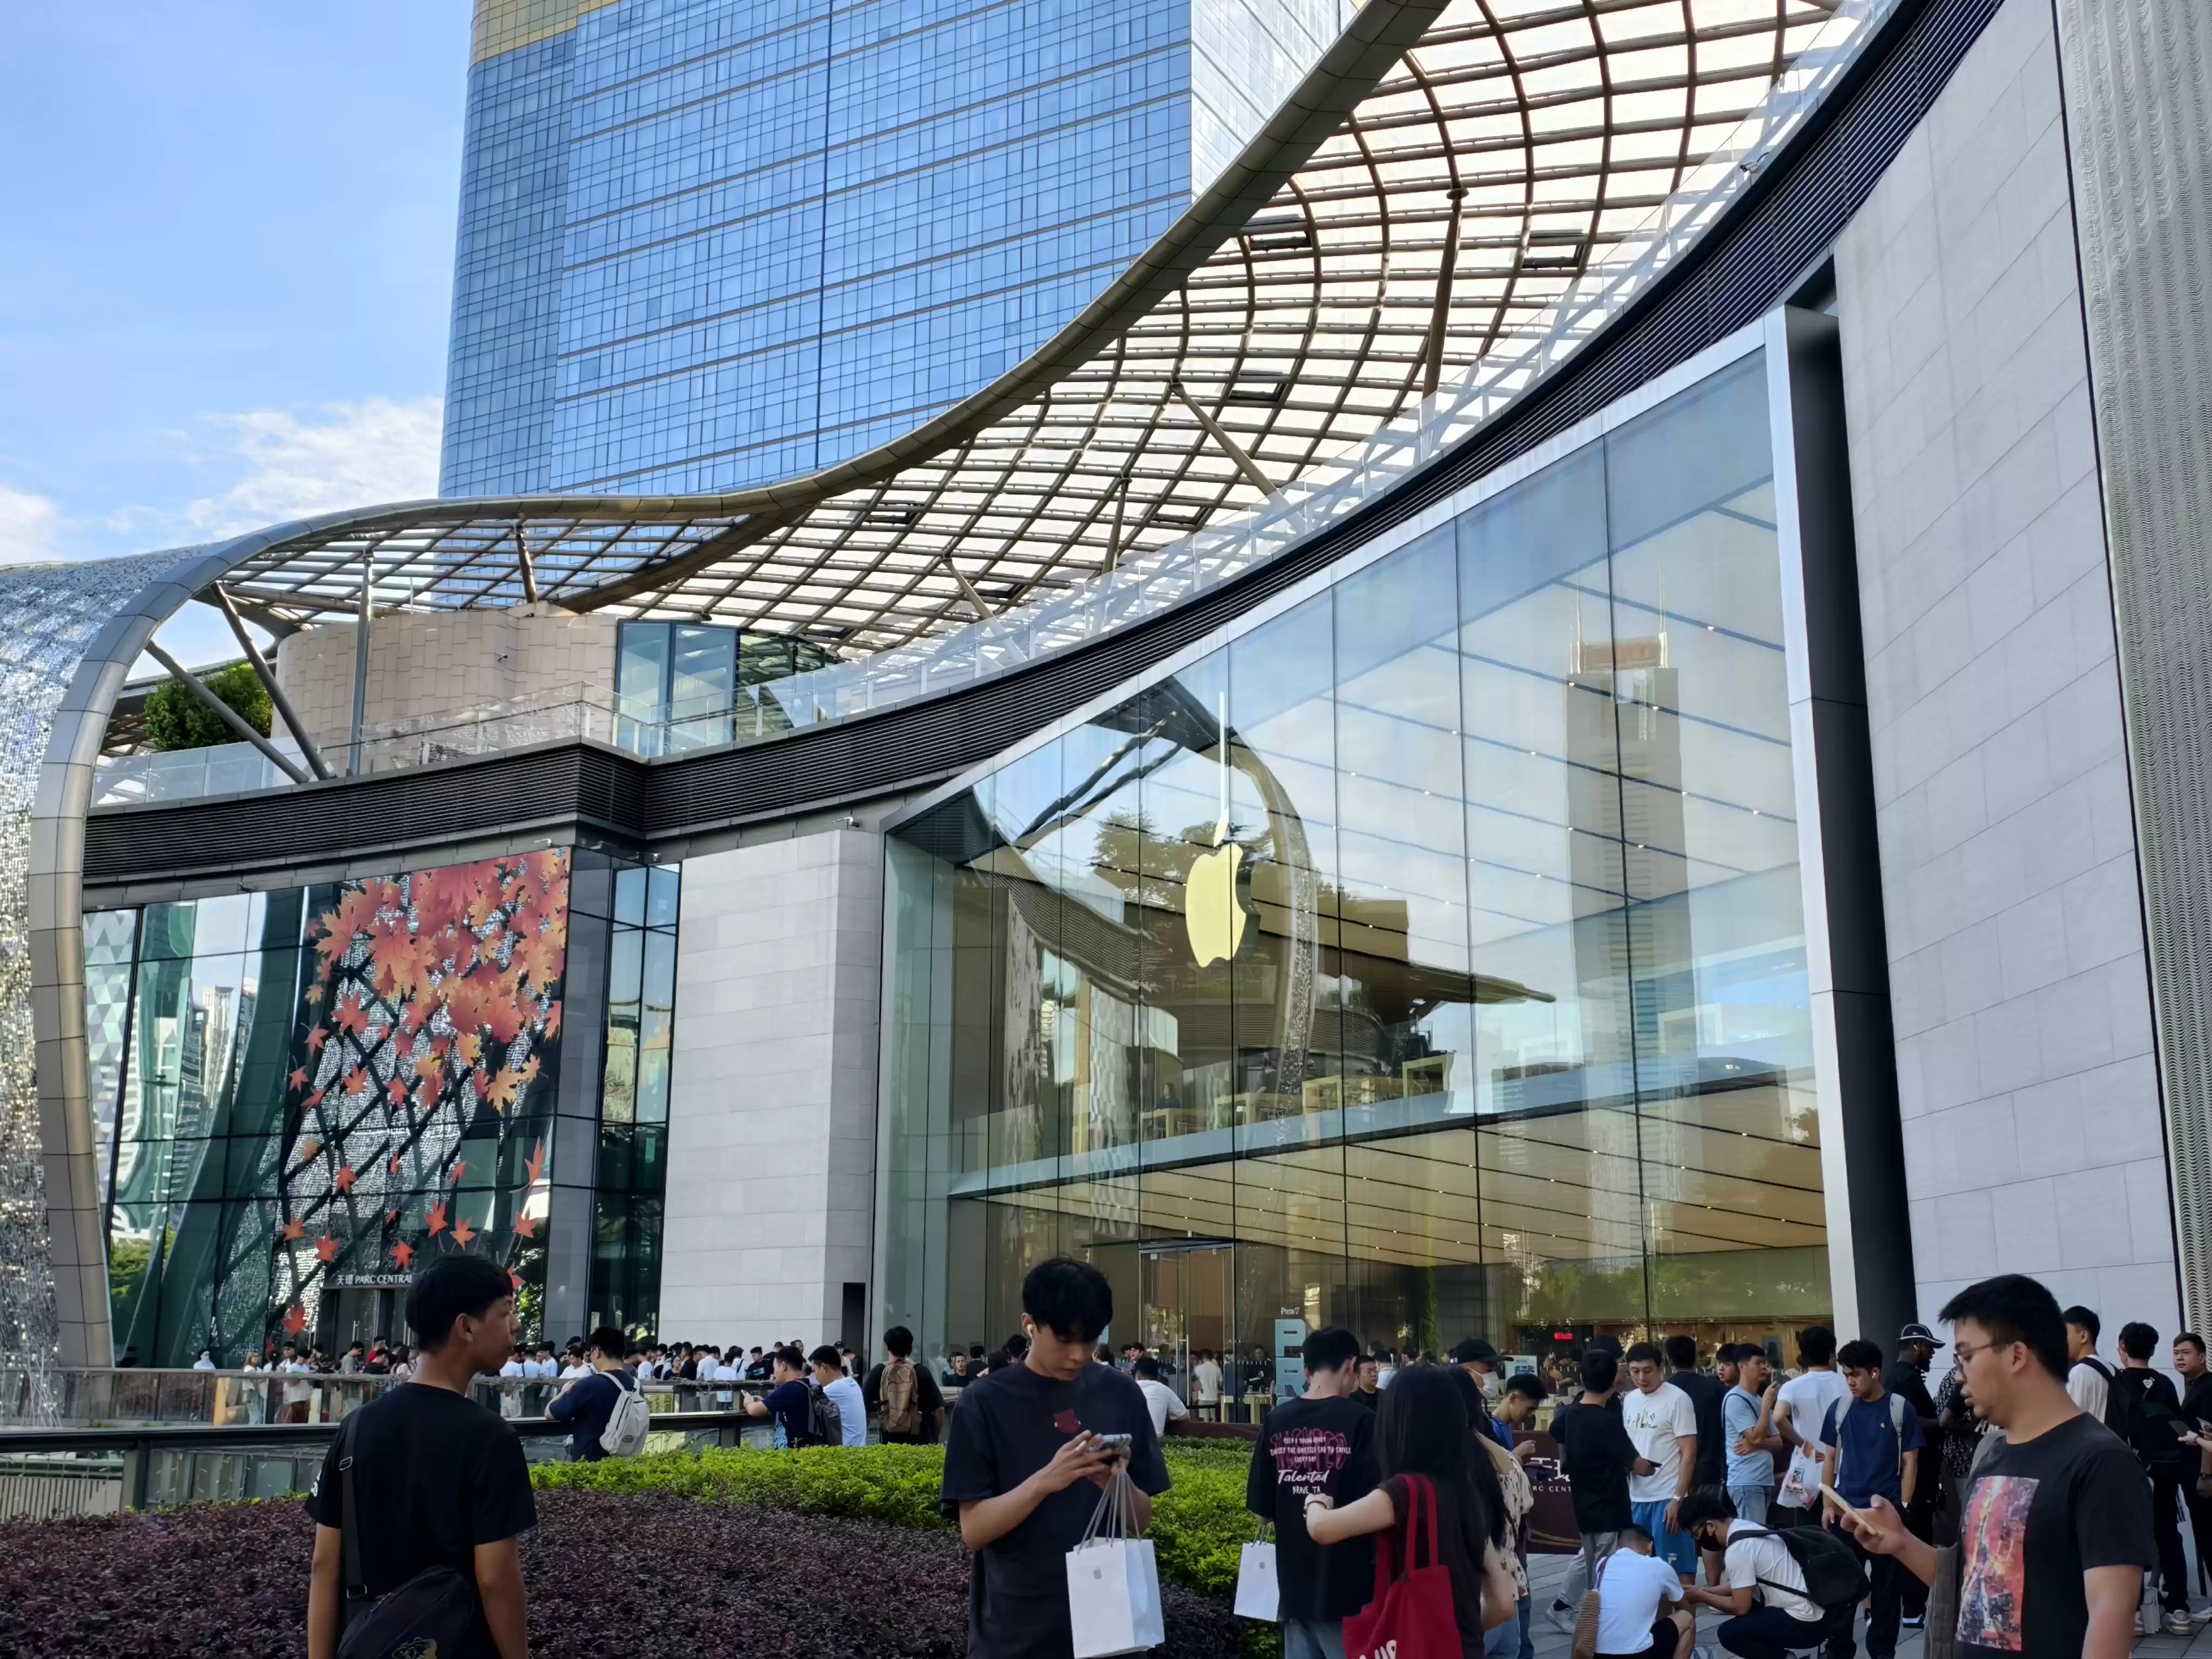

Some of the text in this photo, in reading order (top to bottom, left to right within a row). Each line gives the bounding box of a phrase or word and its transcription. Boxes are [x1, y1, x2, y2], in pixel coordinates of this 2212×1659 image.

[355, 1274, 376, 1284] PARC
[377, 1274, 413, 1284] CENTRAL
[1278, 1469, 1330, 1485] Talented
